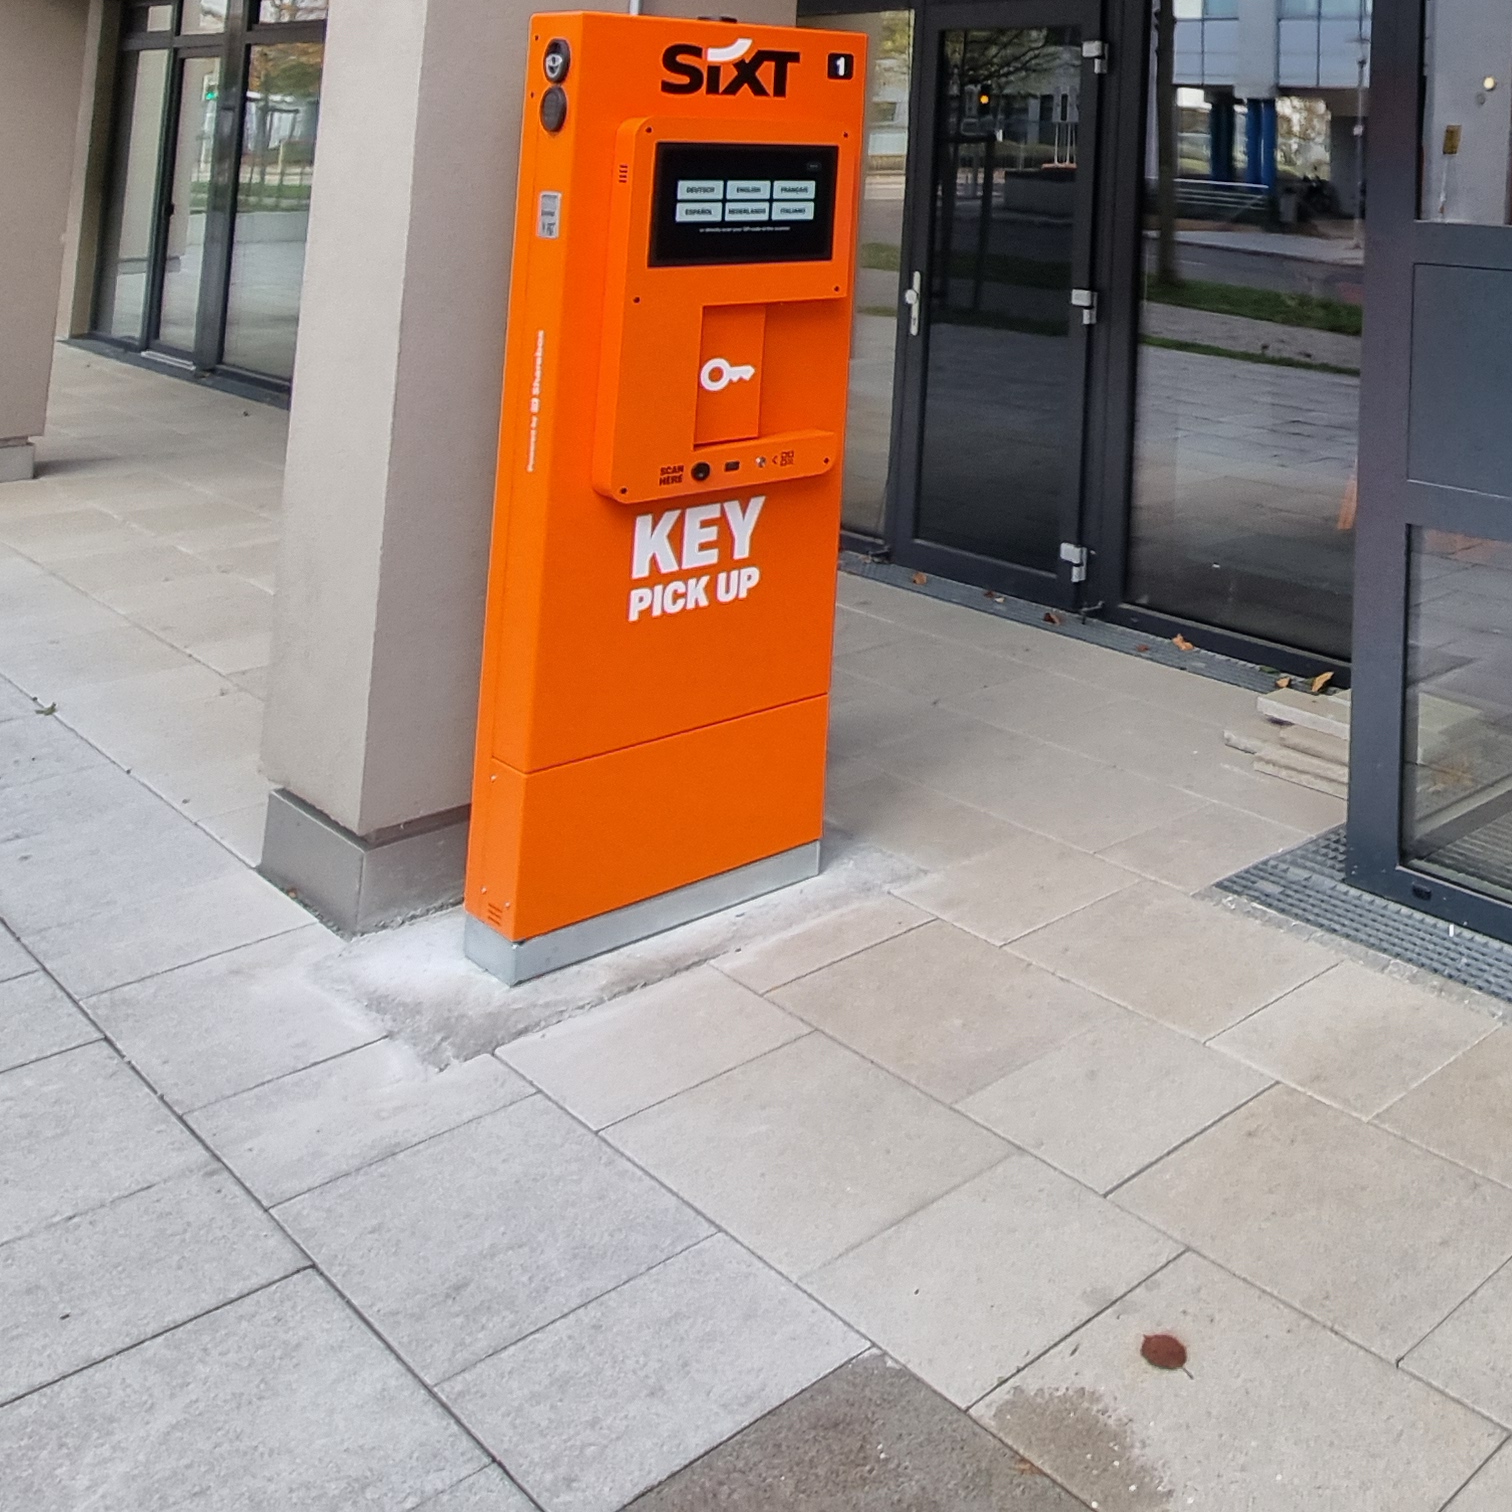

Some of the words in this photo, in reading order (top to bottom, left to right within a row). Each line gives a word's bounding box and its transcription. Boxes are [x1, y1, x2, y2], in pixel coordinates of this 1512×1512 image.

[659, 474, 683, 486] HERE
[660, 465, 684, 476] SCAN
[631, 496, 766, 578] KEY
[628, 575, 710, 622] PICK
[716, 566, 760, 603] UP
